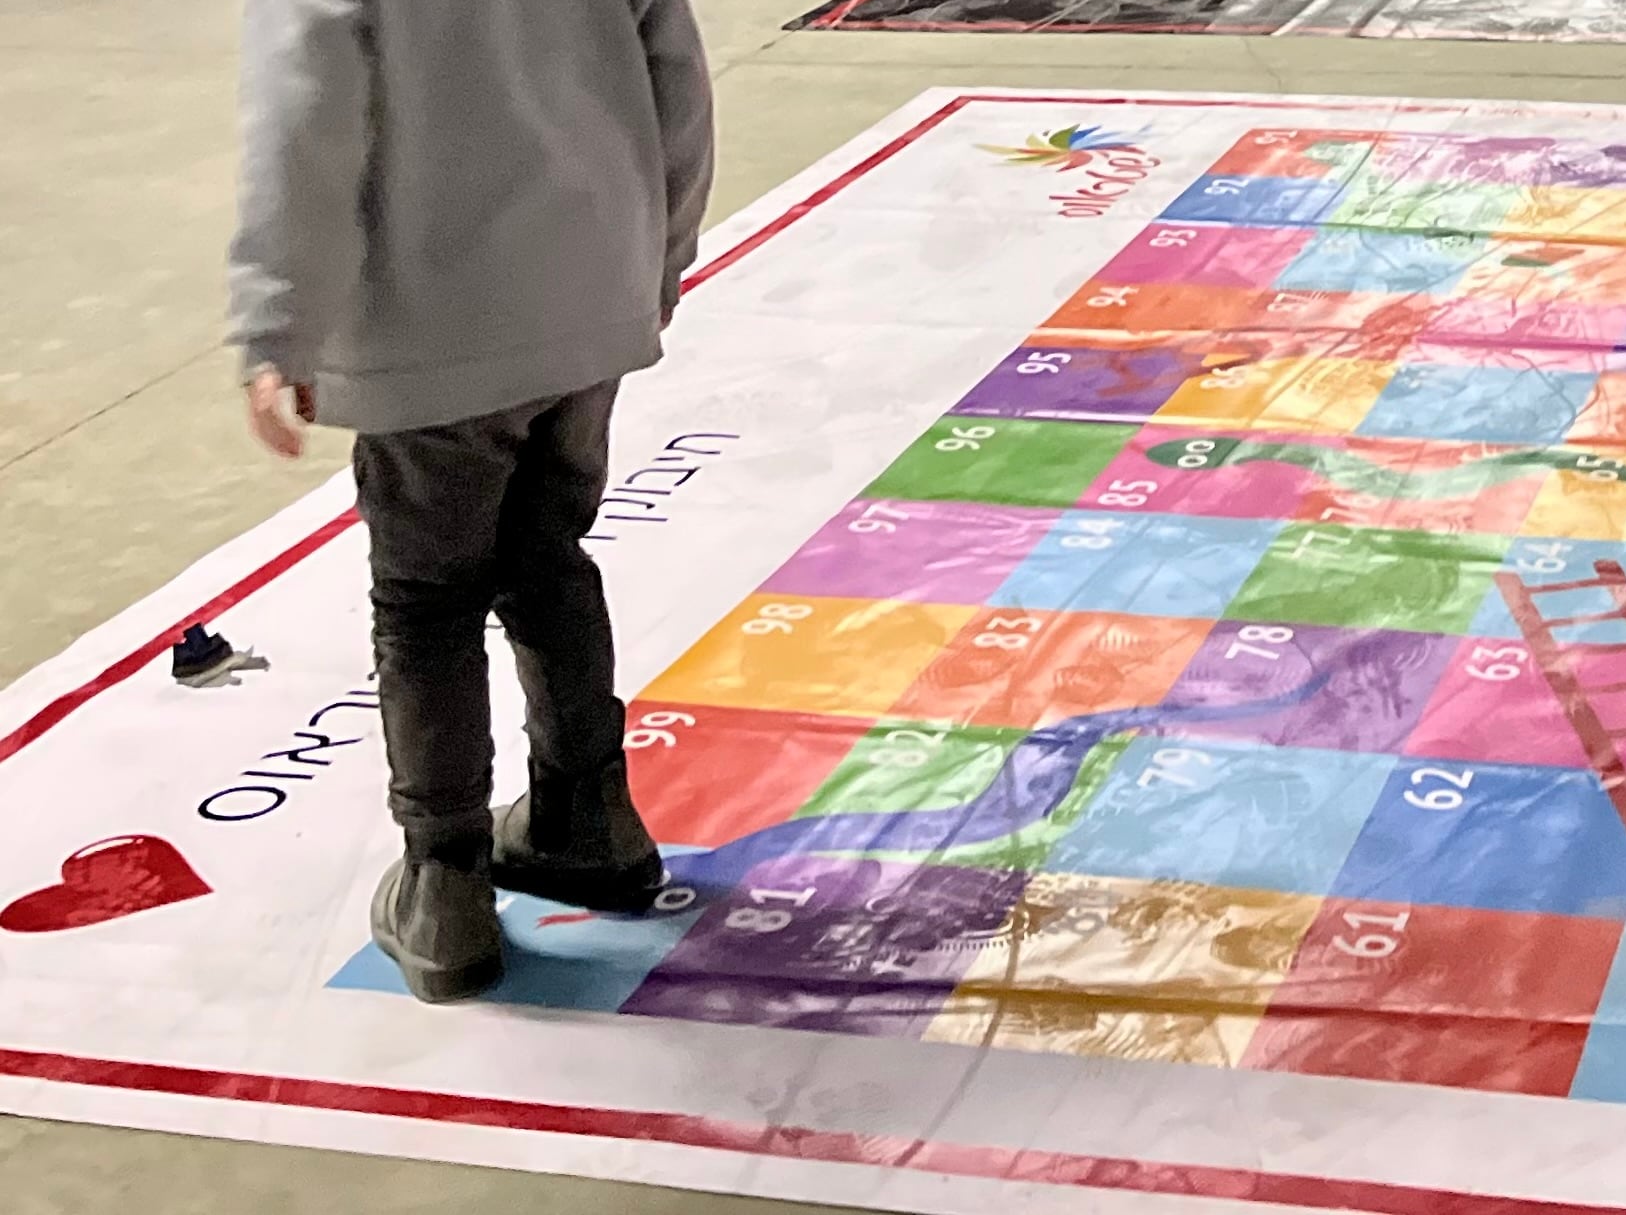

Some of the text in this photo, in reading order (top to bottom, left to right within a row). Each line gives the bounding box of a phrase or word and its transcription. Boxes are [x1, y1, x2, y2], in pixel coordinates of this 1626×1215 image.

[1204, 176, 1249, 196] 92
[1149, 226, 1198, 248] 93
[1086, 285, 1140, 308] 94
[1015, 349, 1074, 376] 95
[934, 424, 996, 452] 96
[1576, 455, 1623, 482] 65
[1098, 479, 1158, 507] 85
[848, 504, 910, 534] 97
[1061, 517, 1125, 550] 84
[1517, 539, 1572, 575] 64
[742, 602, 813, 636] 98
[974, 616, 1044, 650] 83
[1225, 625, 1295, 662] 78
[1465, 645, 1530, 681] 63
[623, 710, 696, 750] 99
[1138, 749, 1213, 787] 79
[1403, 766, 1474, 812] 62
[725, 884, 817, 933] 81
[1334, 907, 1410, 959] 61
